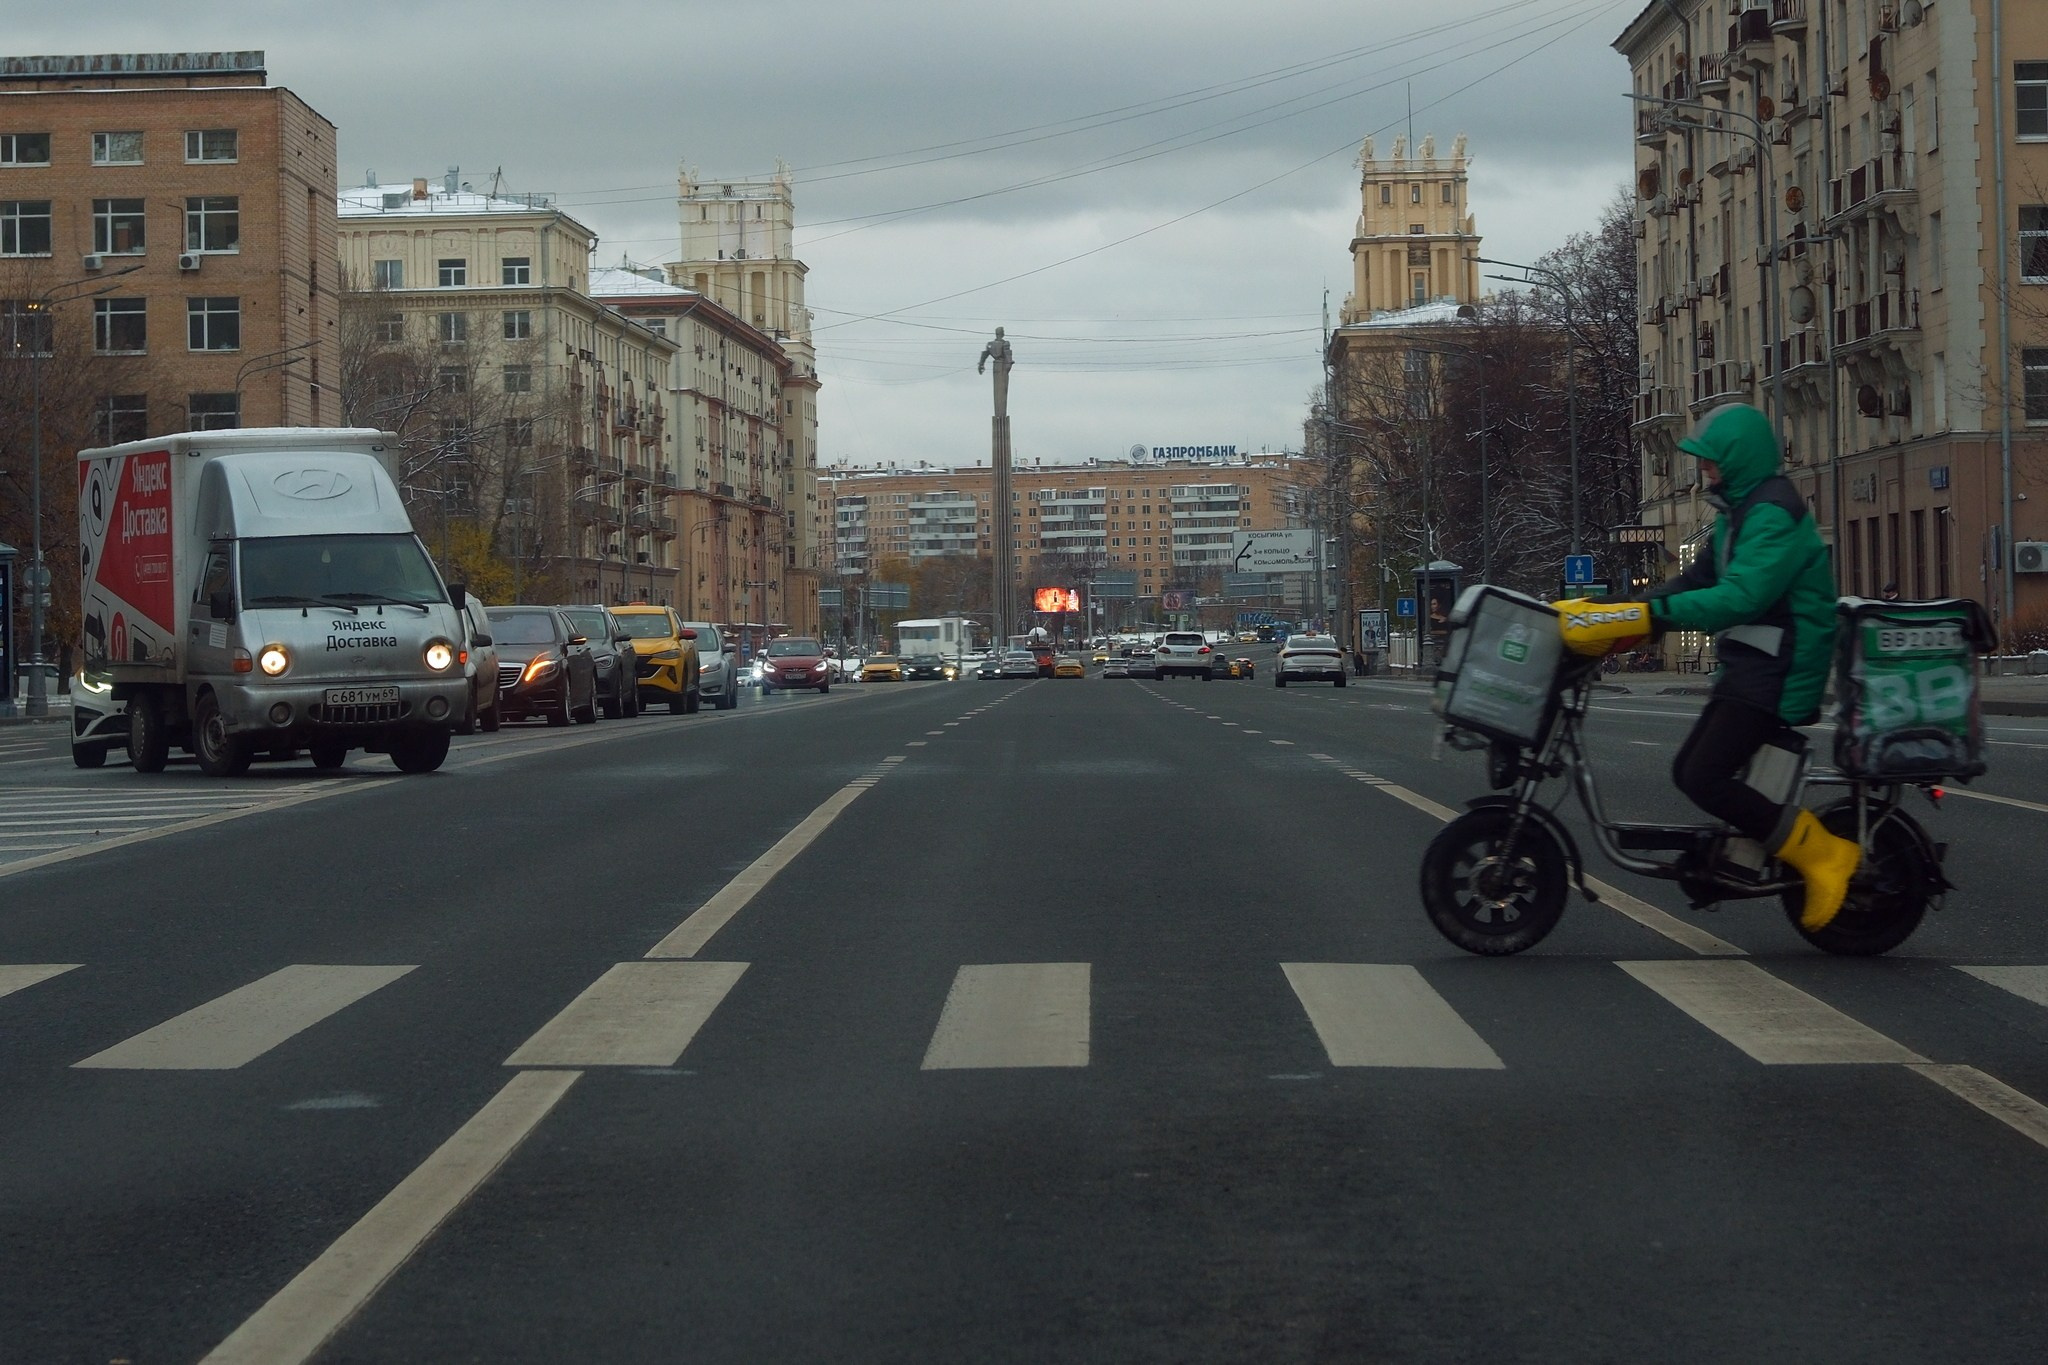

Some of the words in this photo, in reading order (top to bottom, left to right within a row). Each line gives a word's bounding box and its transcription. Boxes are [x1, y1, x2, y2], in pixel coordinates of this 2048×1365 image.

[1152, 445, 1237, 458] ГАЗПРОМБАНК
[132, 456, 167, 497] Яндекс
[122, 501, 167, 544] Доставка
[332, 620, 386, 631] Яндекс
[326, 635, 397, 652] Доставка
[331, 690, 380, 703] С681УМ
[382, 689, 394, 697] 69
